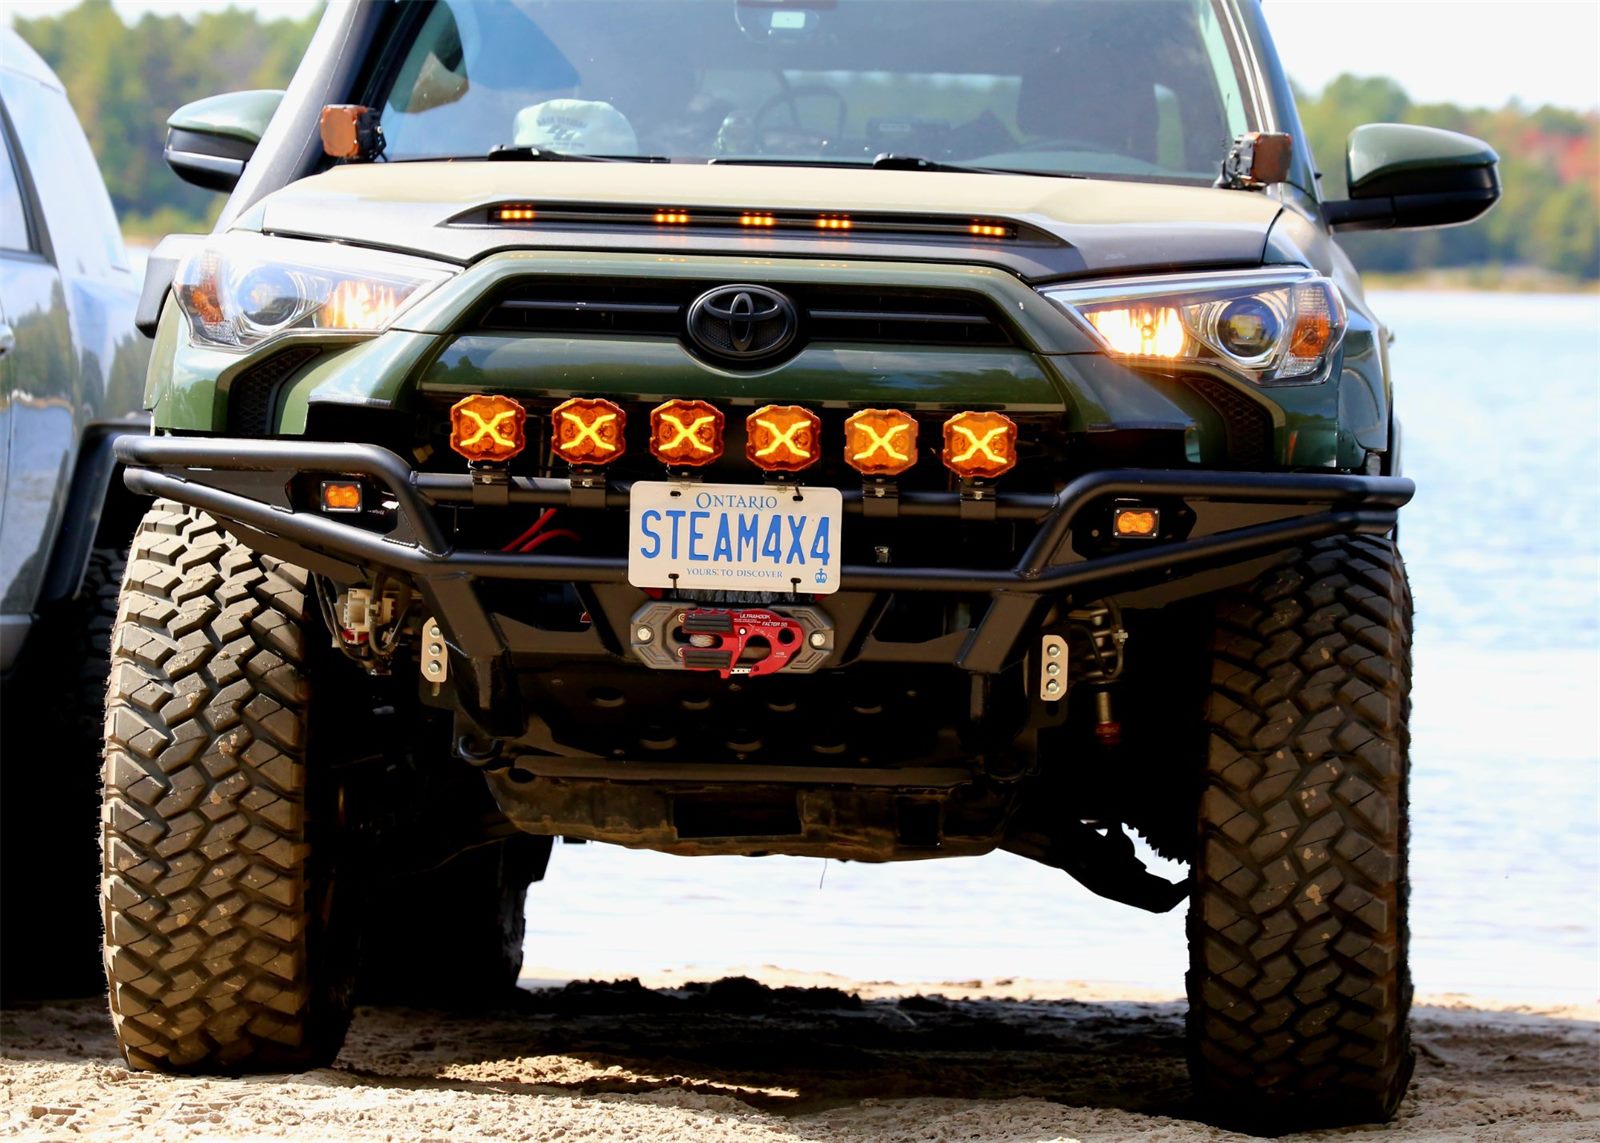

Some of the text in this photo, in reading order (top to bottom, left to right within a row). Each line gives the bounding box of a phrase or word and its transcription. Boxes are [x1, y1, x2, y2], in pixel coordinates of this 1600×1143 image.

[696, 492, 777, 511] ONTARIO
[640, 510, 830, 565] STEAM4X4
[687, 567, 783, 578] YOURS TO DISCOVER
